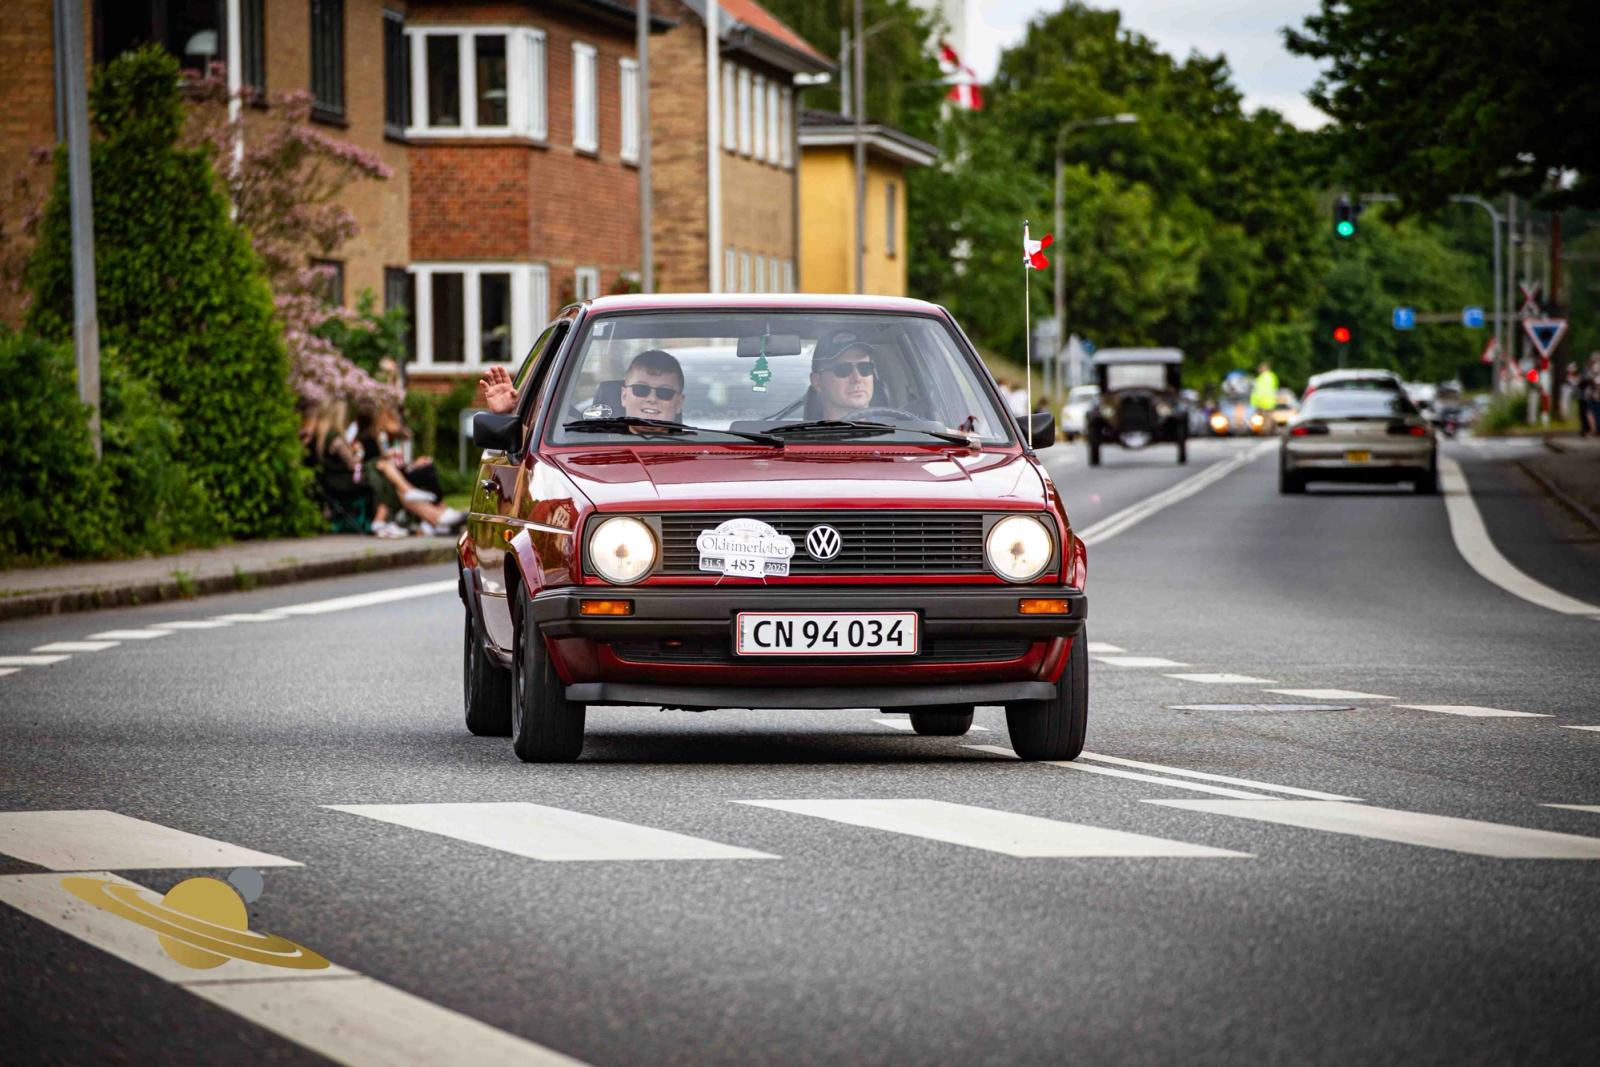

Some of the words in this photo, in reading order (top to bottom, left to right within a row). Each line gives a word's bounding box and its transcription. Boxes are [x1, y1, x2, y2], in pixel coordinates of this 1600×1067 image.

[807, 526, 841, 559] VW
[730, 559, 755, 572] 485
[766, 562, 786, 573] 2025
[753, 620, 793, 648] CN
[802, 620, 839, 649] 94
[847, 620, 903, 648] 034
